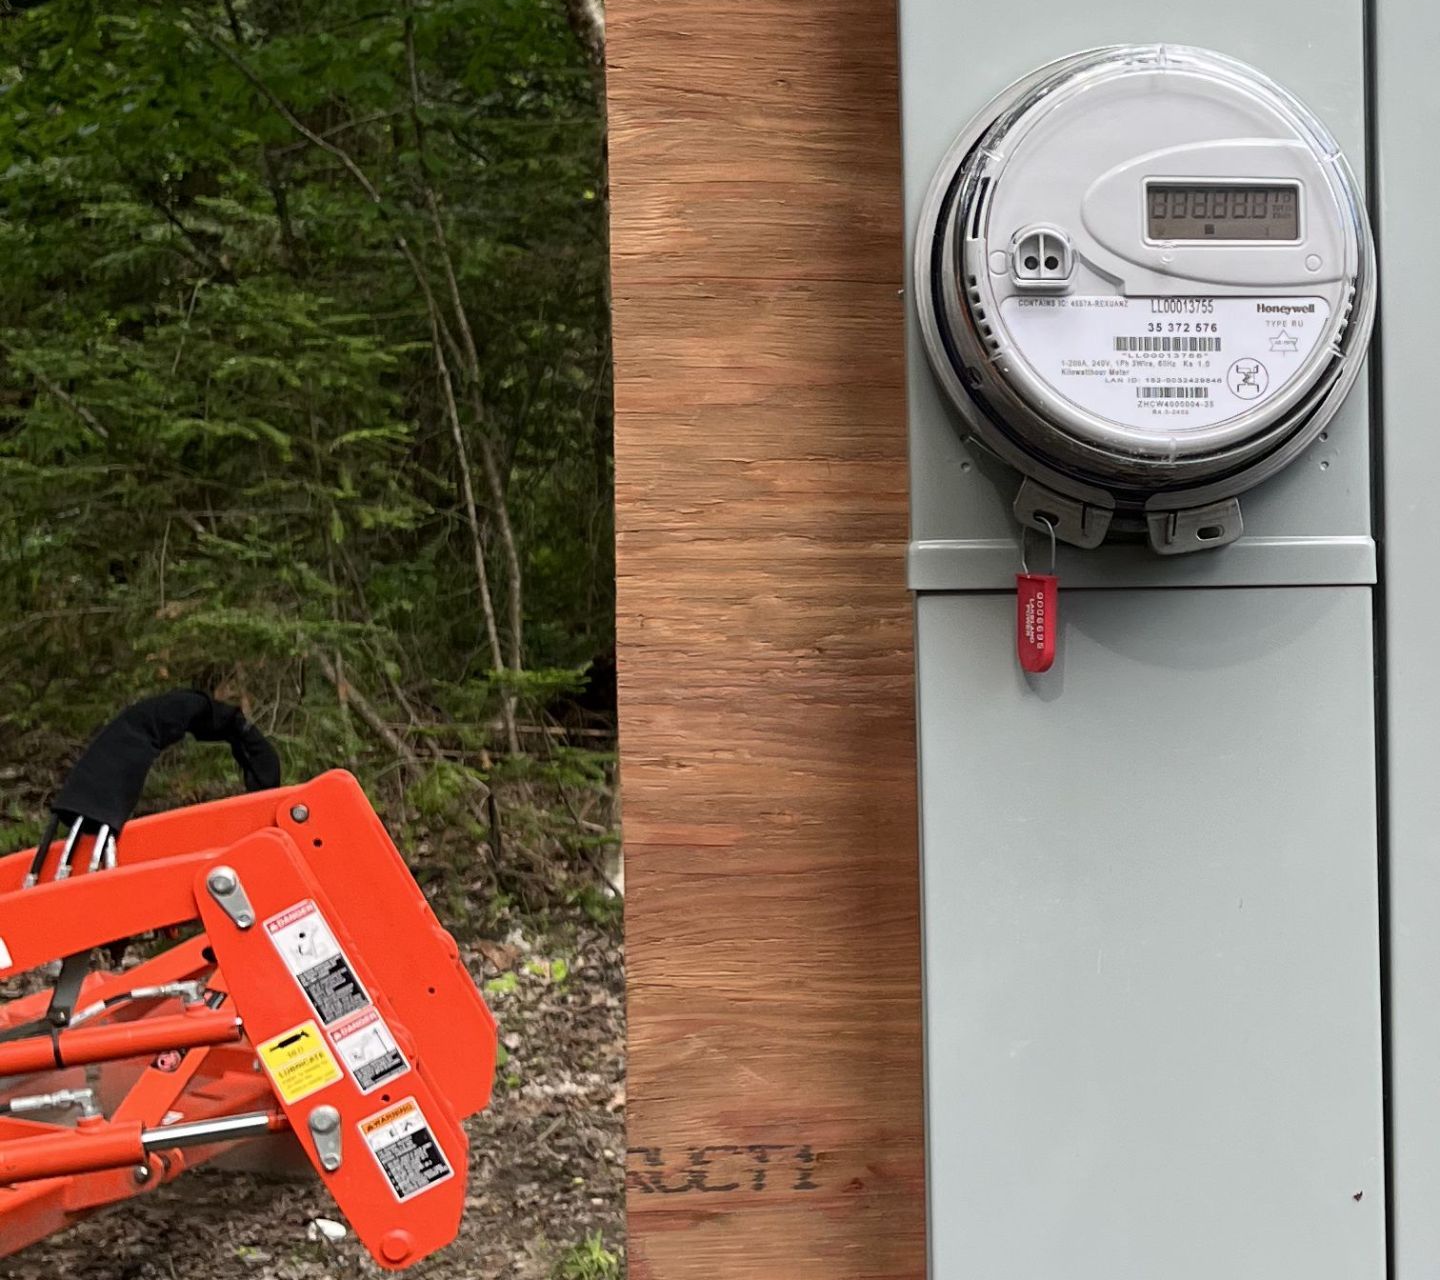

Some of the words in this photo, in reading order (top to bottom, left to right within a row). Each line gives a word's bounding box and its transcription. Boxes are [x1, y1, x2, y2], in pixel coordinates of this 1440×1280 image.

[1150, 298, 1215, 315] LL00013755
[1256, 303, 1316, 316] Honeywell
[1147, 322, 1163, 333] 35
[1167, 322, 1191, 333] 372
[1195, 322, 1218, 333] 576
[1266, 319, 1288, 328] TYPE
[1108, 368, 1130, 376] Meter
